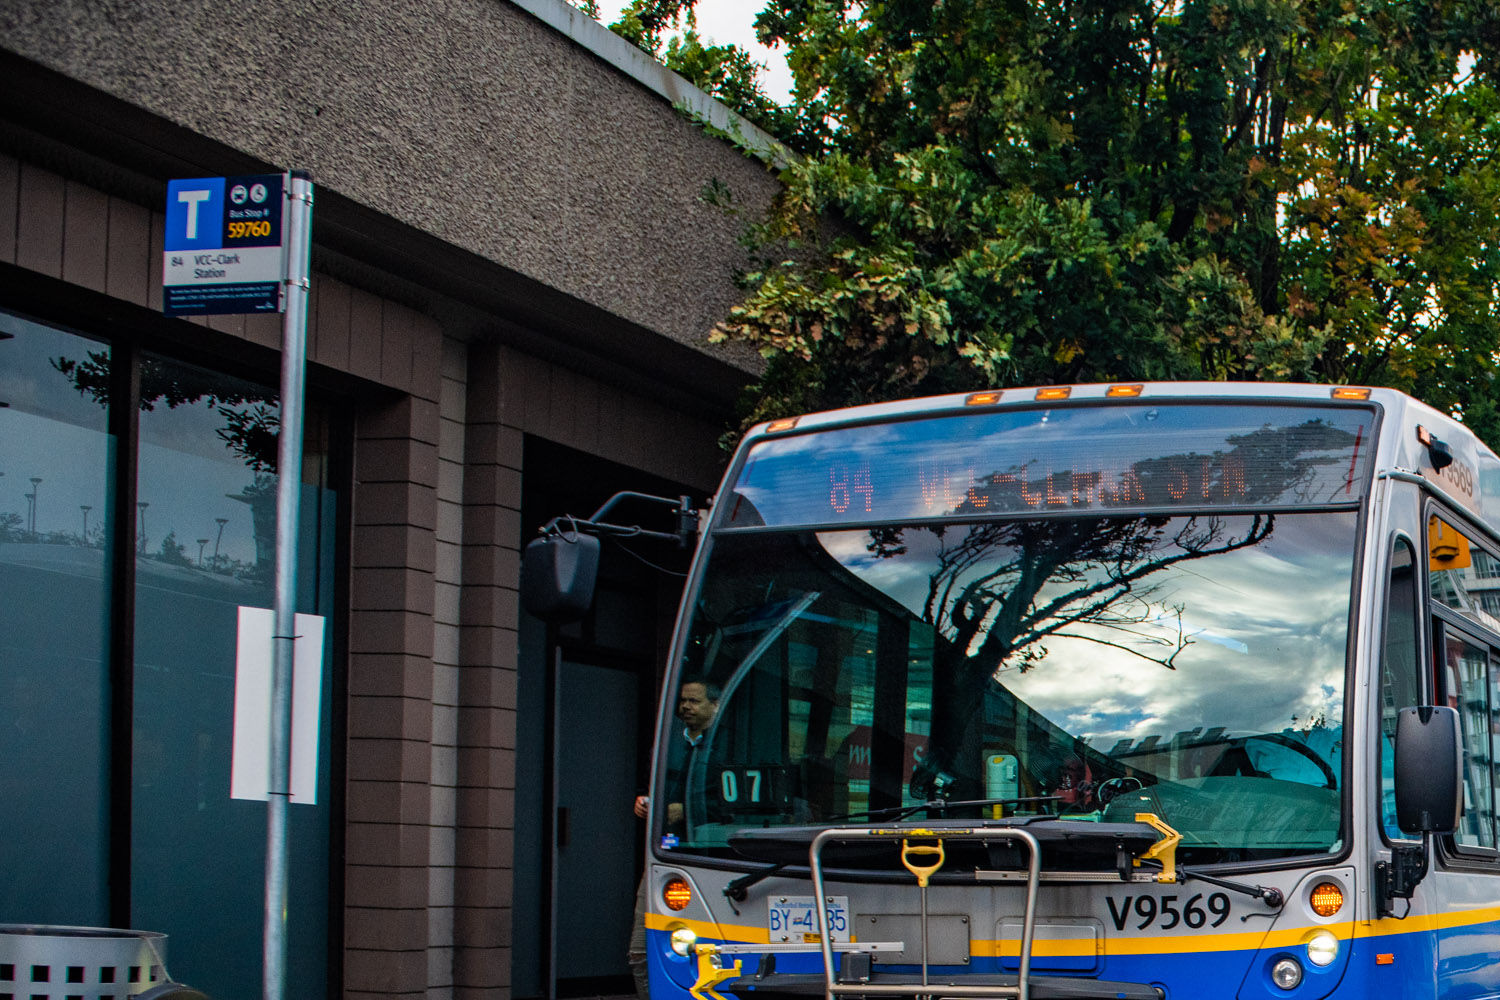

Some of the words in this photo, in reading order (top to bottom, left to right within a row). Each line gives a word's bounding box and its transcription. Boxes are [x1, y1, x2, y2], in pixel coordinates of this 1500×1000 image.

[177, 190, 211, 239] T
[227, 220, 271, 239] 59760
[171, 256, 184, 267] 84
[194, 254, 240, 266] VCC-Clark
[193, 268, 226, 279] Station
[721, 770, 761, 802] 07
[1105, 892, 1231, 931] V9569
